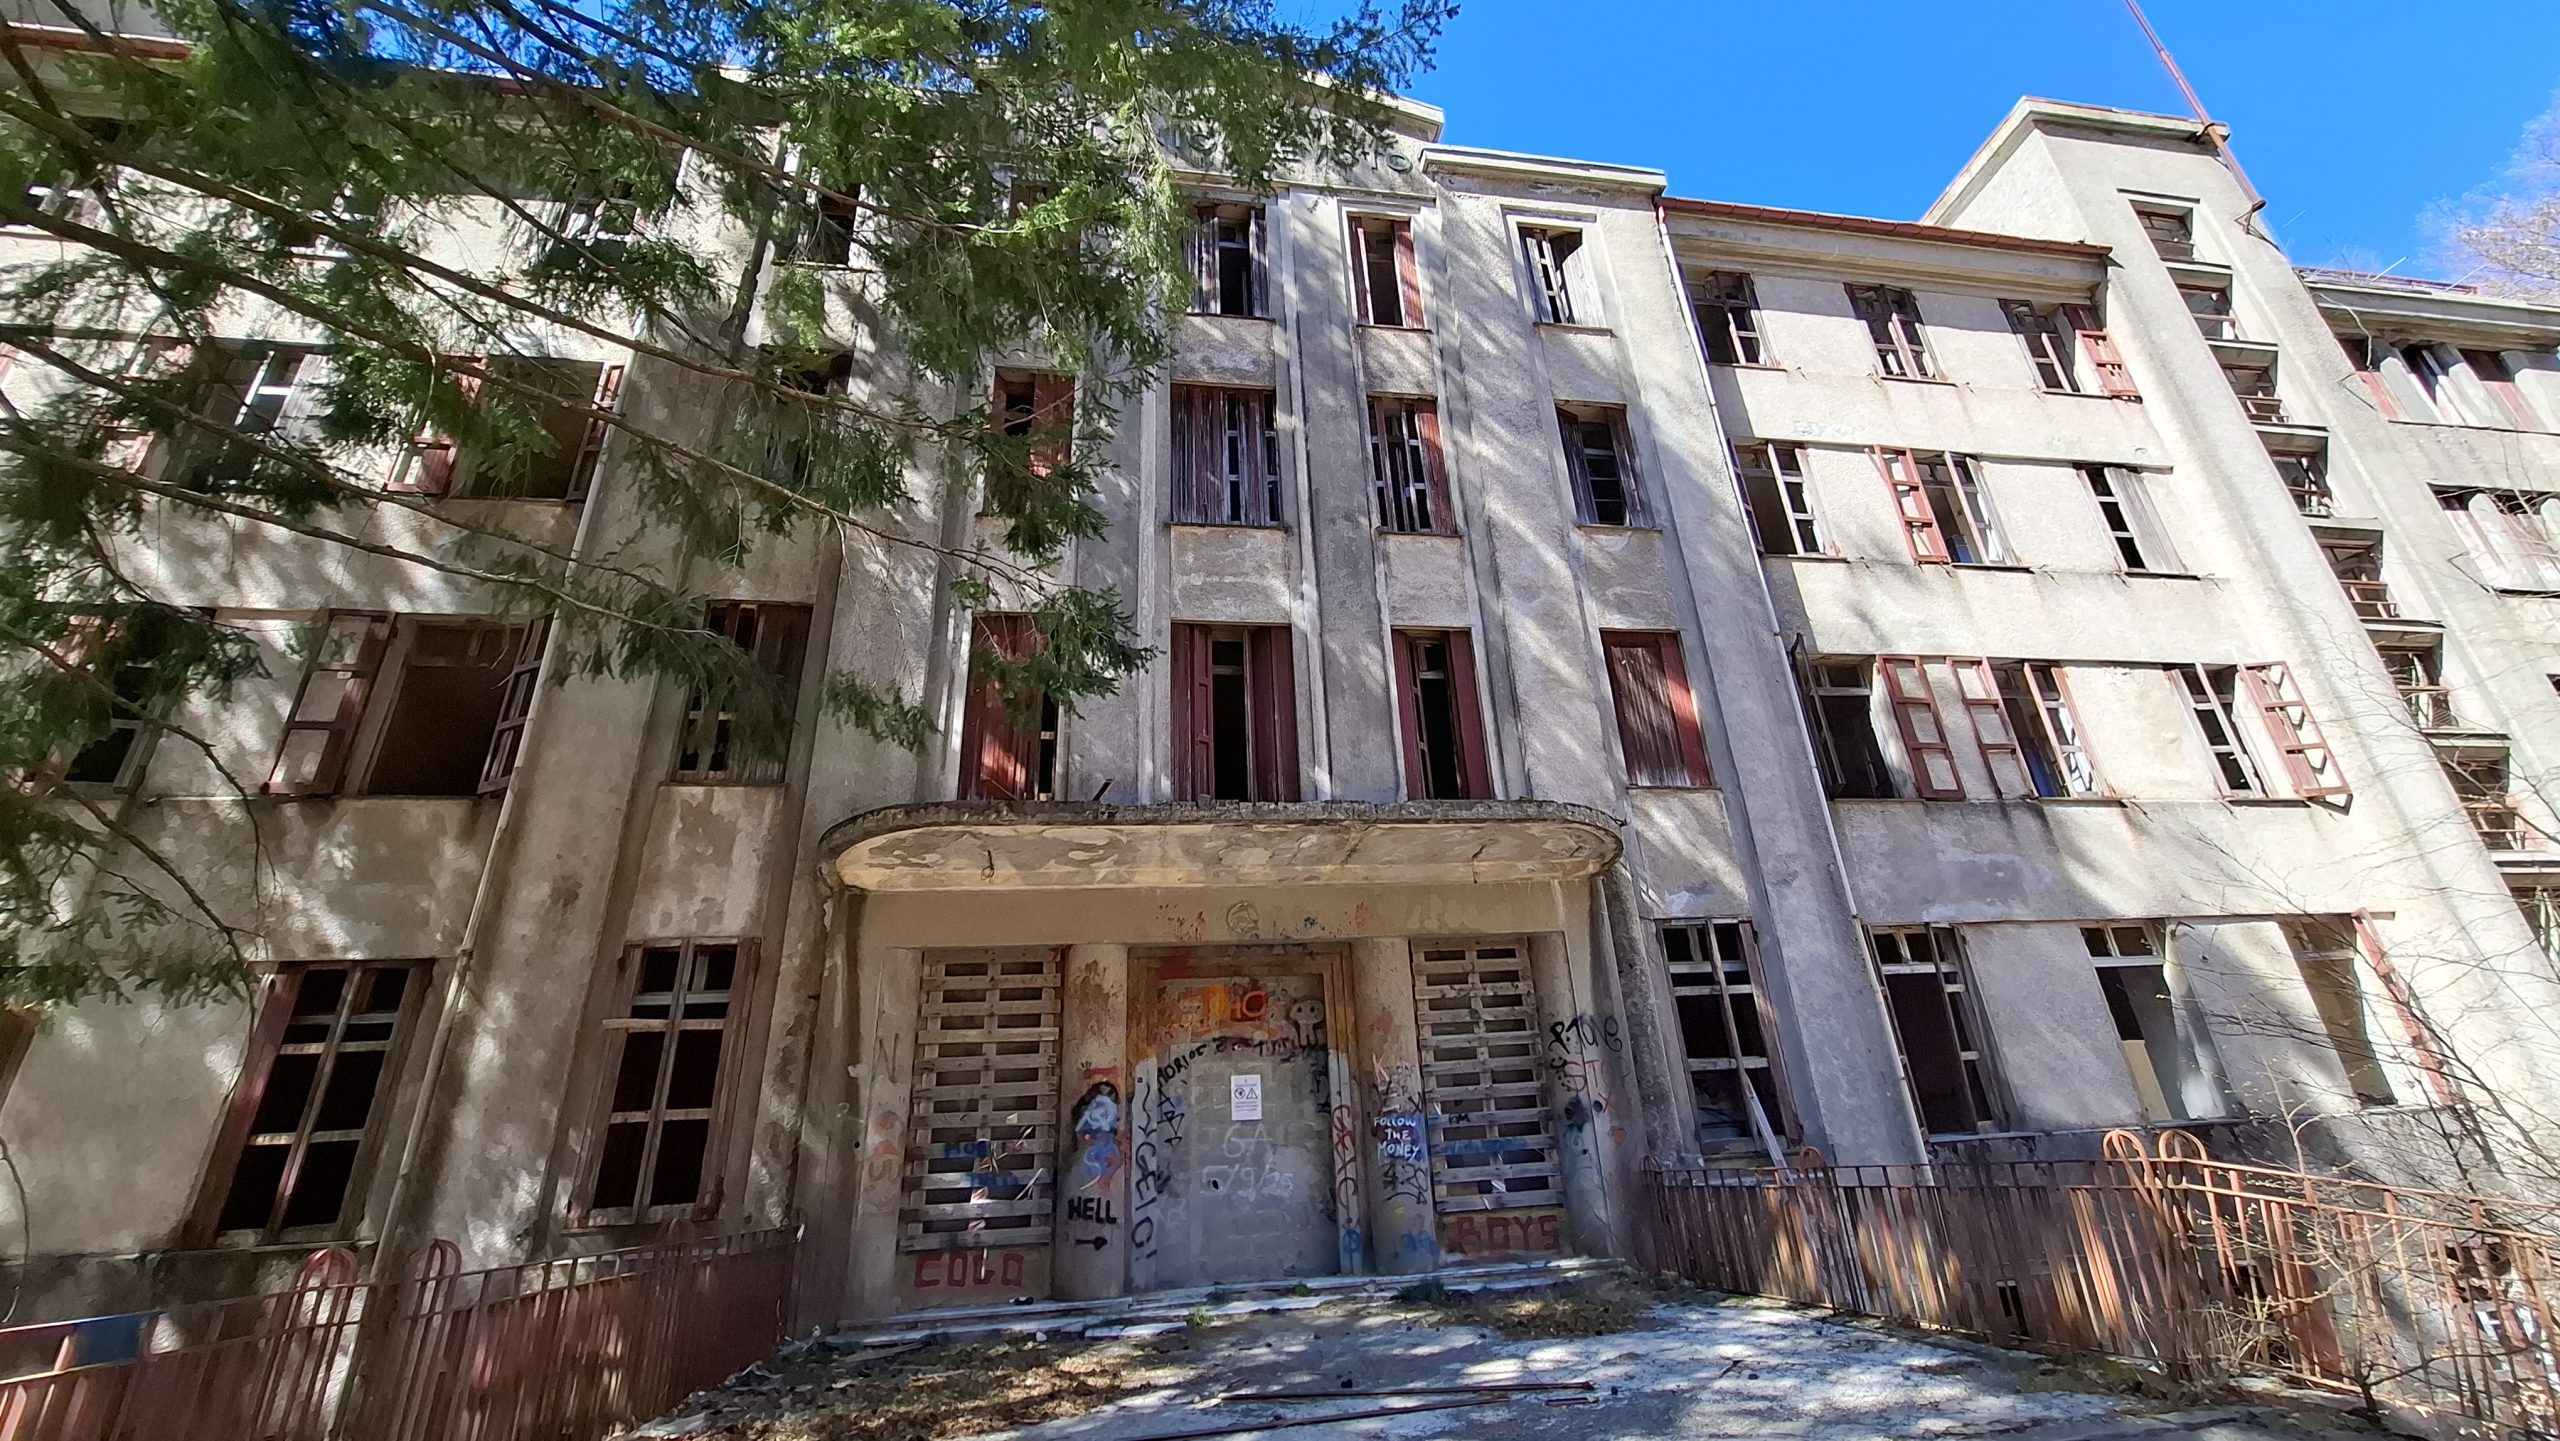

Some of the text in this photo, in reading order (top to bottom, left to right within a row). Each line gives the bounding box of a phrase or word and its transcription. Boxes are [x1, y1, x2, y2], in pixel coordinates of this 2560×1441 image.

[1373, 1116, 1417, 1128] FOLLOW
[1384, 1128, 1412, 1141] THE
[1377, 1140, 1421, 1163] MONEY
[1067, 1195, 1118, 1225] HELL
[1455, 1214, 1561, 1254] BOYS
